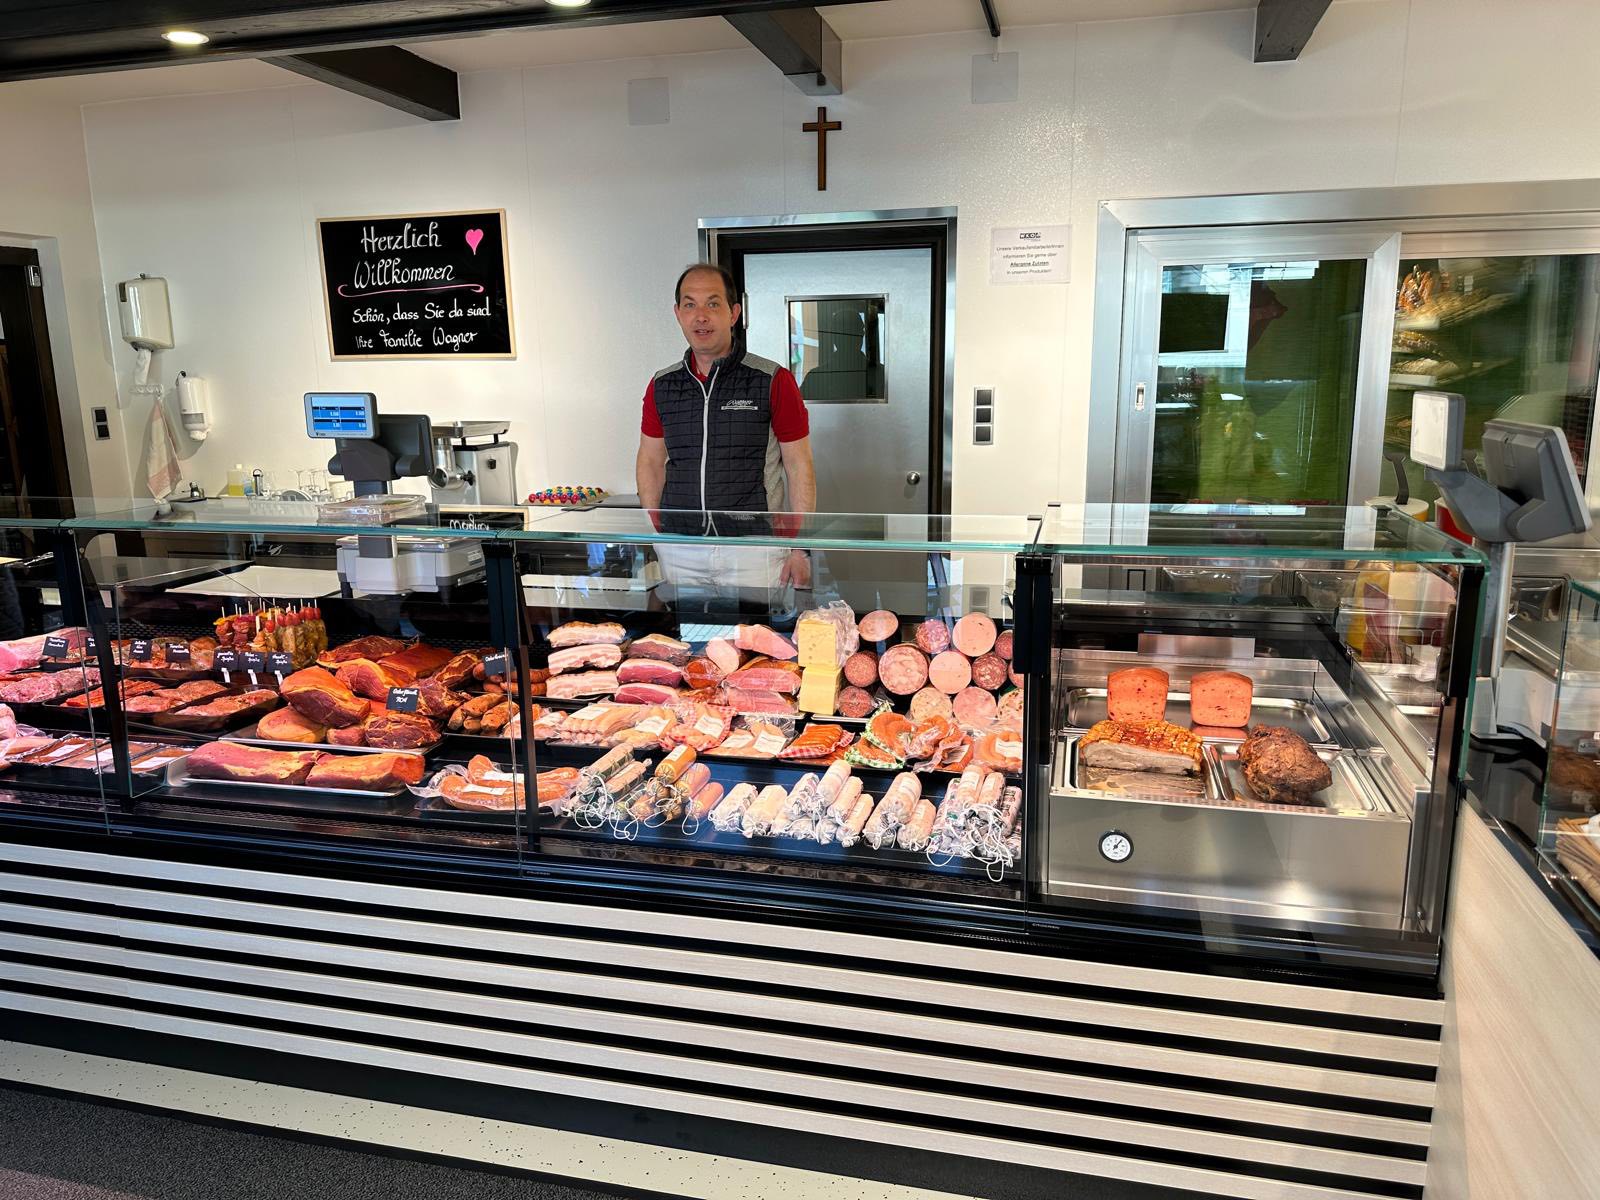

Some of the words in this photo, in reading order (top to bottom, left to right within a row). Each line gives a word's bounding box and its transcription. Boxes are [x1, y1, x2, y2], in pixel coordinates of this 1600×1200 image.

[361, 222, 442, 253] Herzlich
[354, 258, 455, 289] Willkommen
[352, 307, 391, 325] Schön,
[393, 302, 419, 320] dass
[425, 303, 445, 319] Sie
[449, 298, 463, 318] da
[467, 296, 491, 317] sind
[355, 336, 373, 349] Ihre
[379, 329, 423, 348] Familie
[432, 327, 478, 351] Wagner
